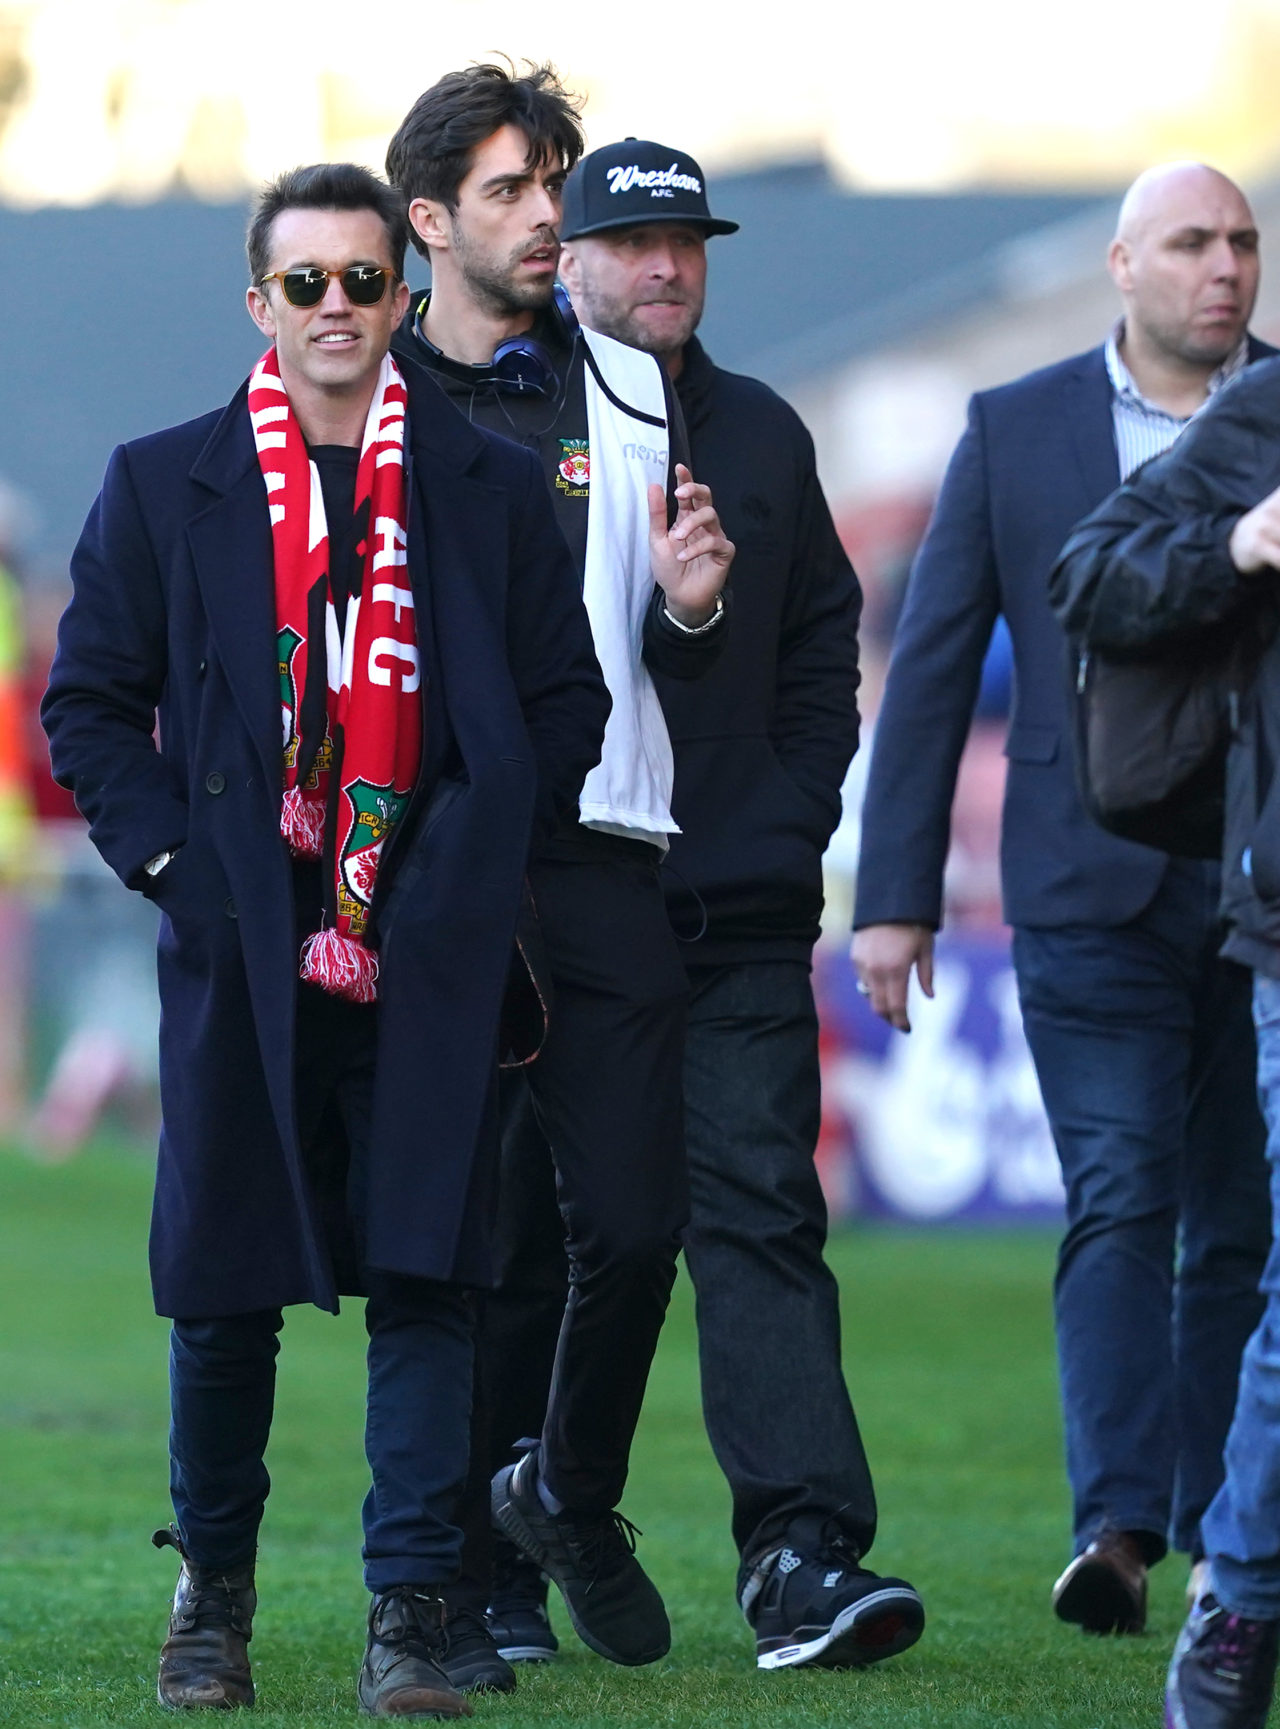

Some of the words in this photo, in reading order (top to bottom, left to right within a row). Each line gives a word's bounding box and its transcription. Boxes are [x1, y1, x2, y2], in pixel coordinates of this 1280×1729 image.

[606, 163, 702, 194] Wrexham
[368, 516, 421, 693] AFC
[361, 813, 378, 825] ICH
